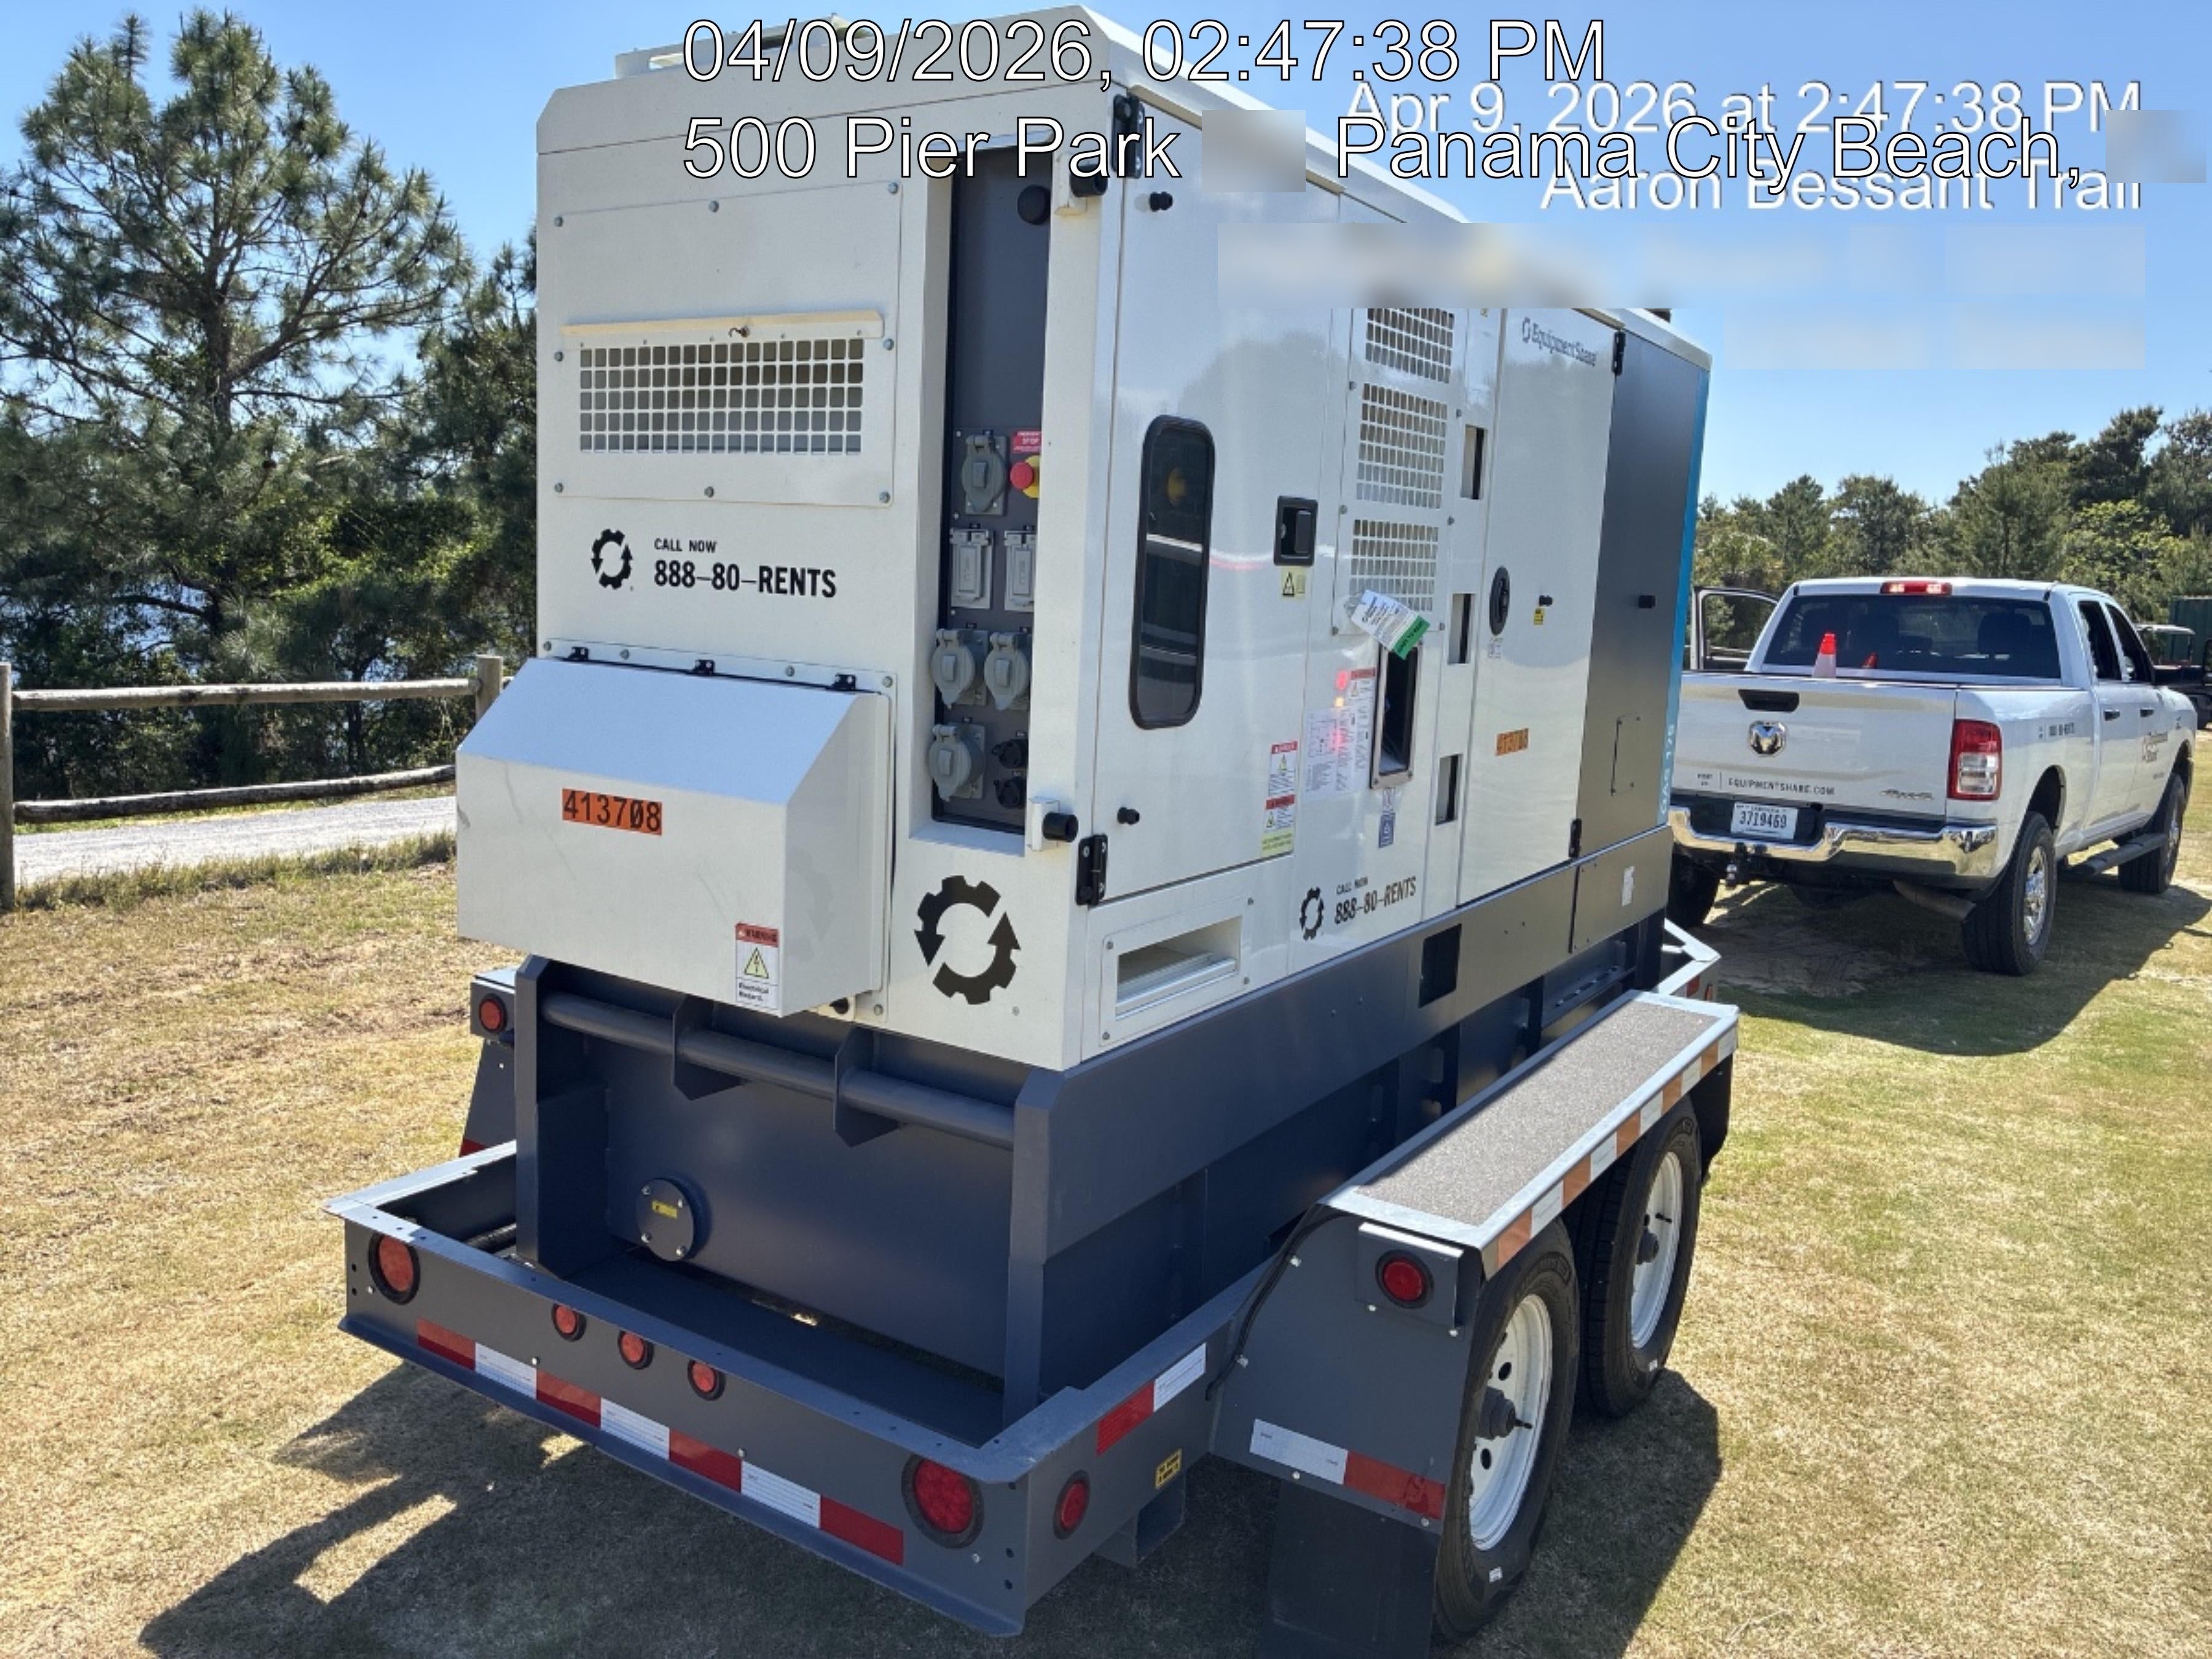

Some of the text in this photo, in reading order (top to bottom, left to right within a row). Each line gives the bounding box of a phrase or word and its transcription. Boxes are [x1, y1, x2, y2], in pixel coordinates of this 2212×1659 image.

[654, 538, 717, 553] CALL NOW
[1728, 777, 1835, 796] EQUIPMENTSHARE.COM
[563, 790, 661, 832] 413708
[1336, 881, 1352, 895] CALL
